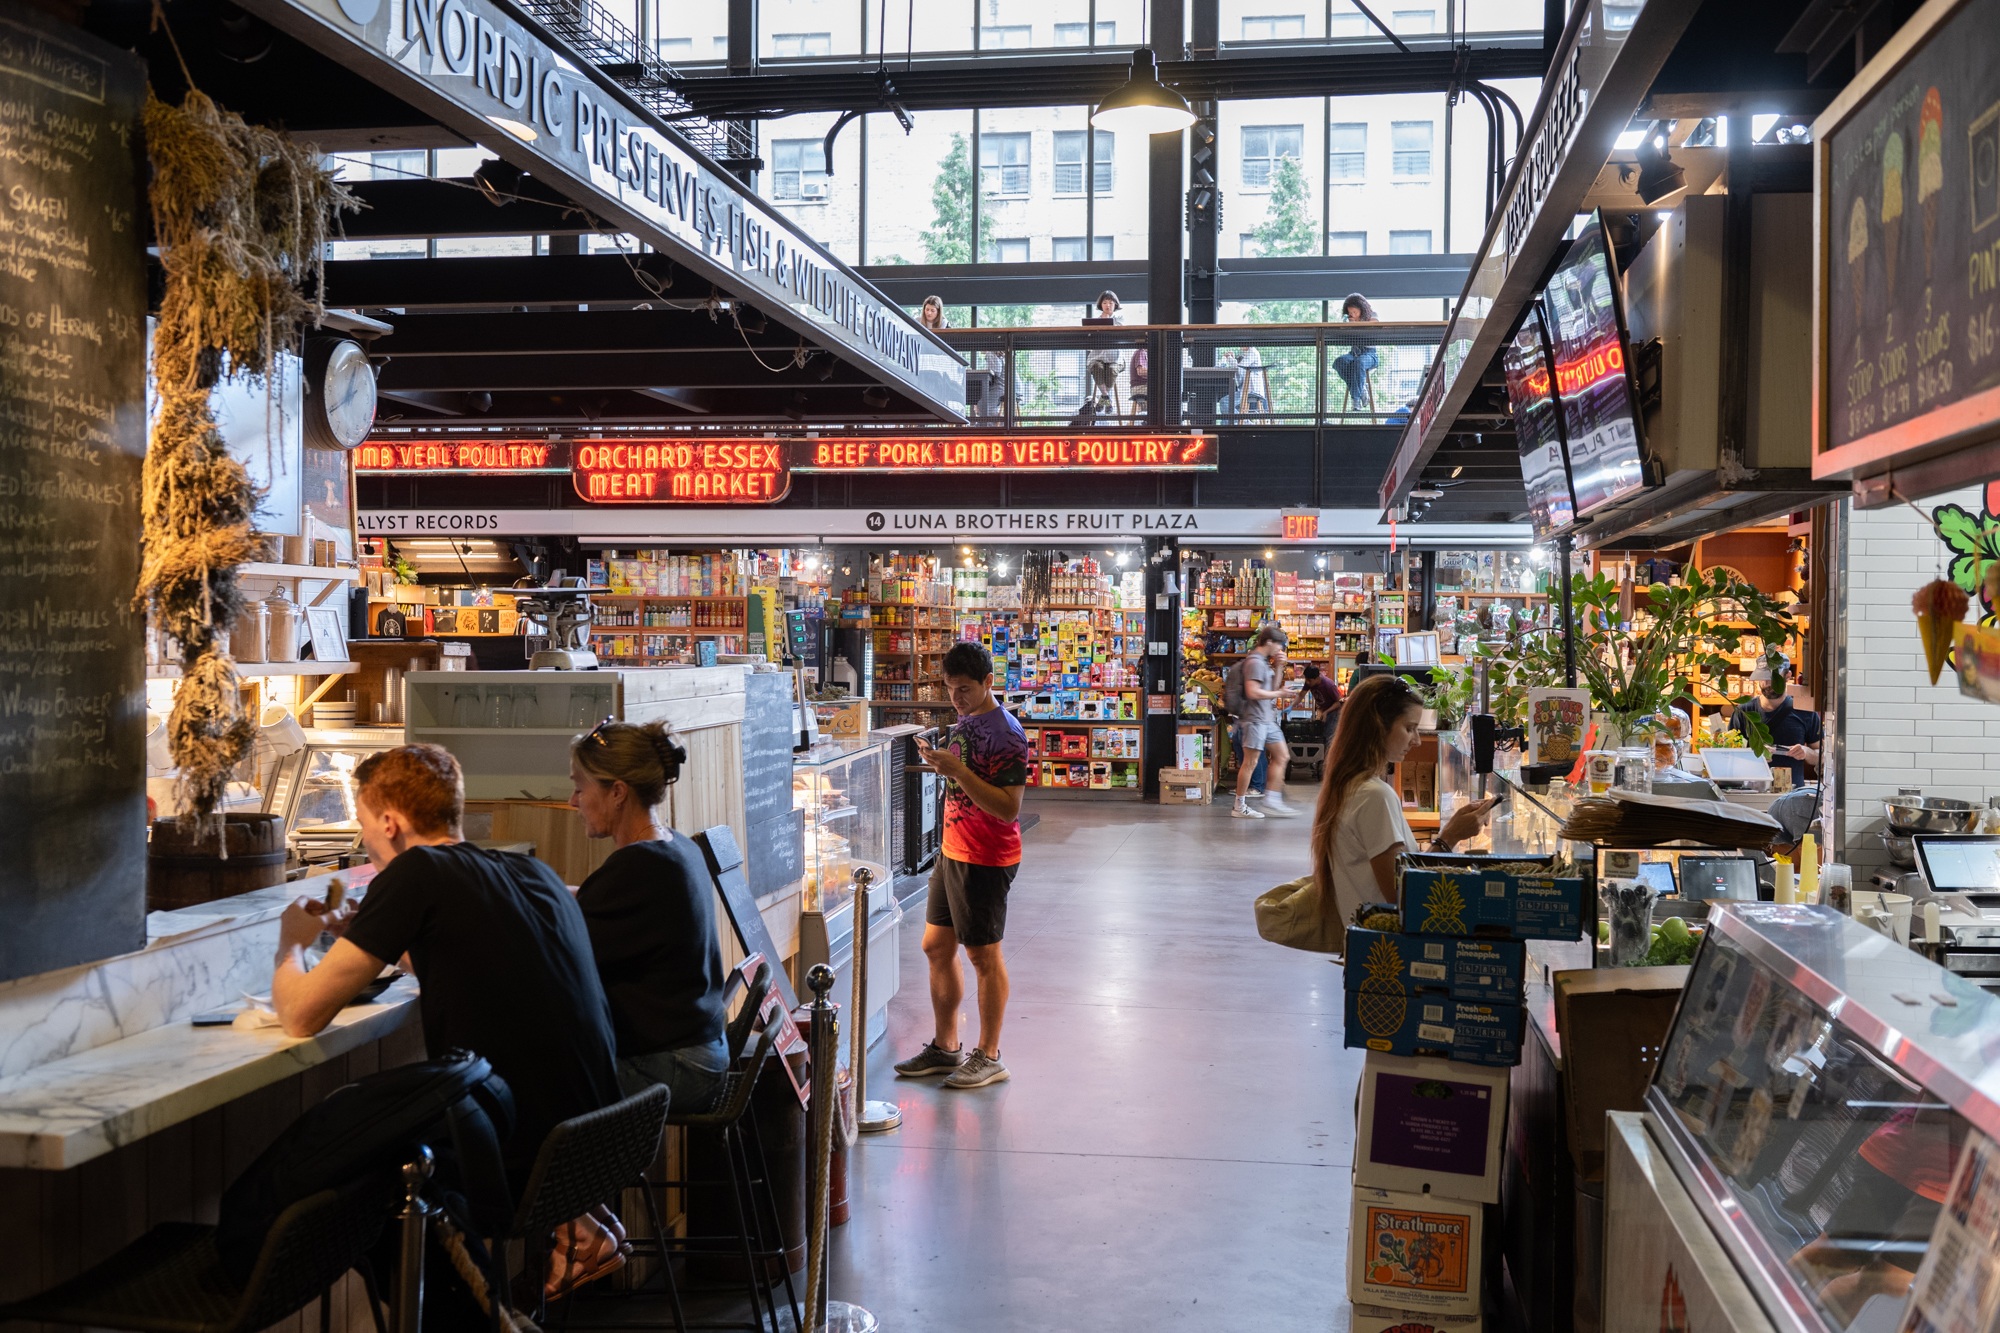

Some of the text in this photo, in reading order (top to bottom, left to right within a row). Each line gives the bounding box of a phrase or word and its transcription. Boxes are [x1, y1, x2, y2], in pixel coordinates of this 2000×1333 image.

[1534, 47, 1581, 202] SQUEEZE
[402, 0, 922, 376] NORDIC PRESERVES, FISH & WILDLIFE COMPANY
[9, 184, 69, 222] SKAGEN
[1925, 286, 1933, 324] 3
[26, 311, 46, 329] OF
[1886, 313, 1895, 344] 2
[1854, 335, 1865, 369] 1
[1847, 362, 1875, 408] SCOOP
[353, 445, 546, 468] AMB VEAL POULTRY
[579, 443, 780, 469] ORCHARD ESSEX
[818, 440, 1172, 465] BEEF PORK LAMB VEAL POULTRY
[589, 472, 776, 497] MEAT MARKET
[356, 514, 499, 530] ALYST RECORDS
[869, 513, 1199, 529] 14 LUNA BROTHERS FRUIT PLAZA
[1287, 516, 1315, 538] EXIT
[323, 629, 330, 637] A
[1534, 699, 1583, 717] SUMMER
[1533, 710, 1585, 727] COLADAS
[1517, 887, 1562, 897] pineapples
[1518, 879, 1541, 888] fresh
[1456, 941, 1479, 951] fresh
[1456, 950, 1500, 960] pineapples
[1455, 1012, 1500, 1023] pineapples
[1456, 1004, 1479, 1013] fresh
[1376, 1213, 1462, 1235] Strathmore
[1397, 1290, 1429, 1299] ORCHARDS
[1430, 1294, 1469, 1302] ASSOCIATION
[1444, 1315, 1477, 1323] GRAPEFRUIT
